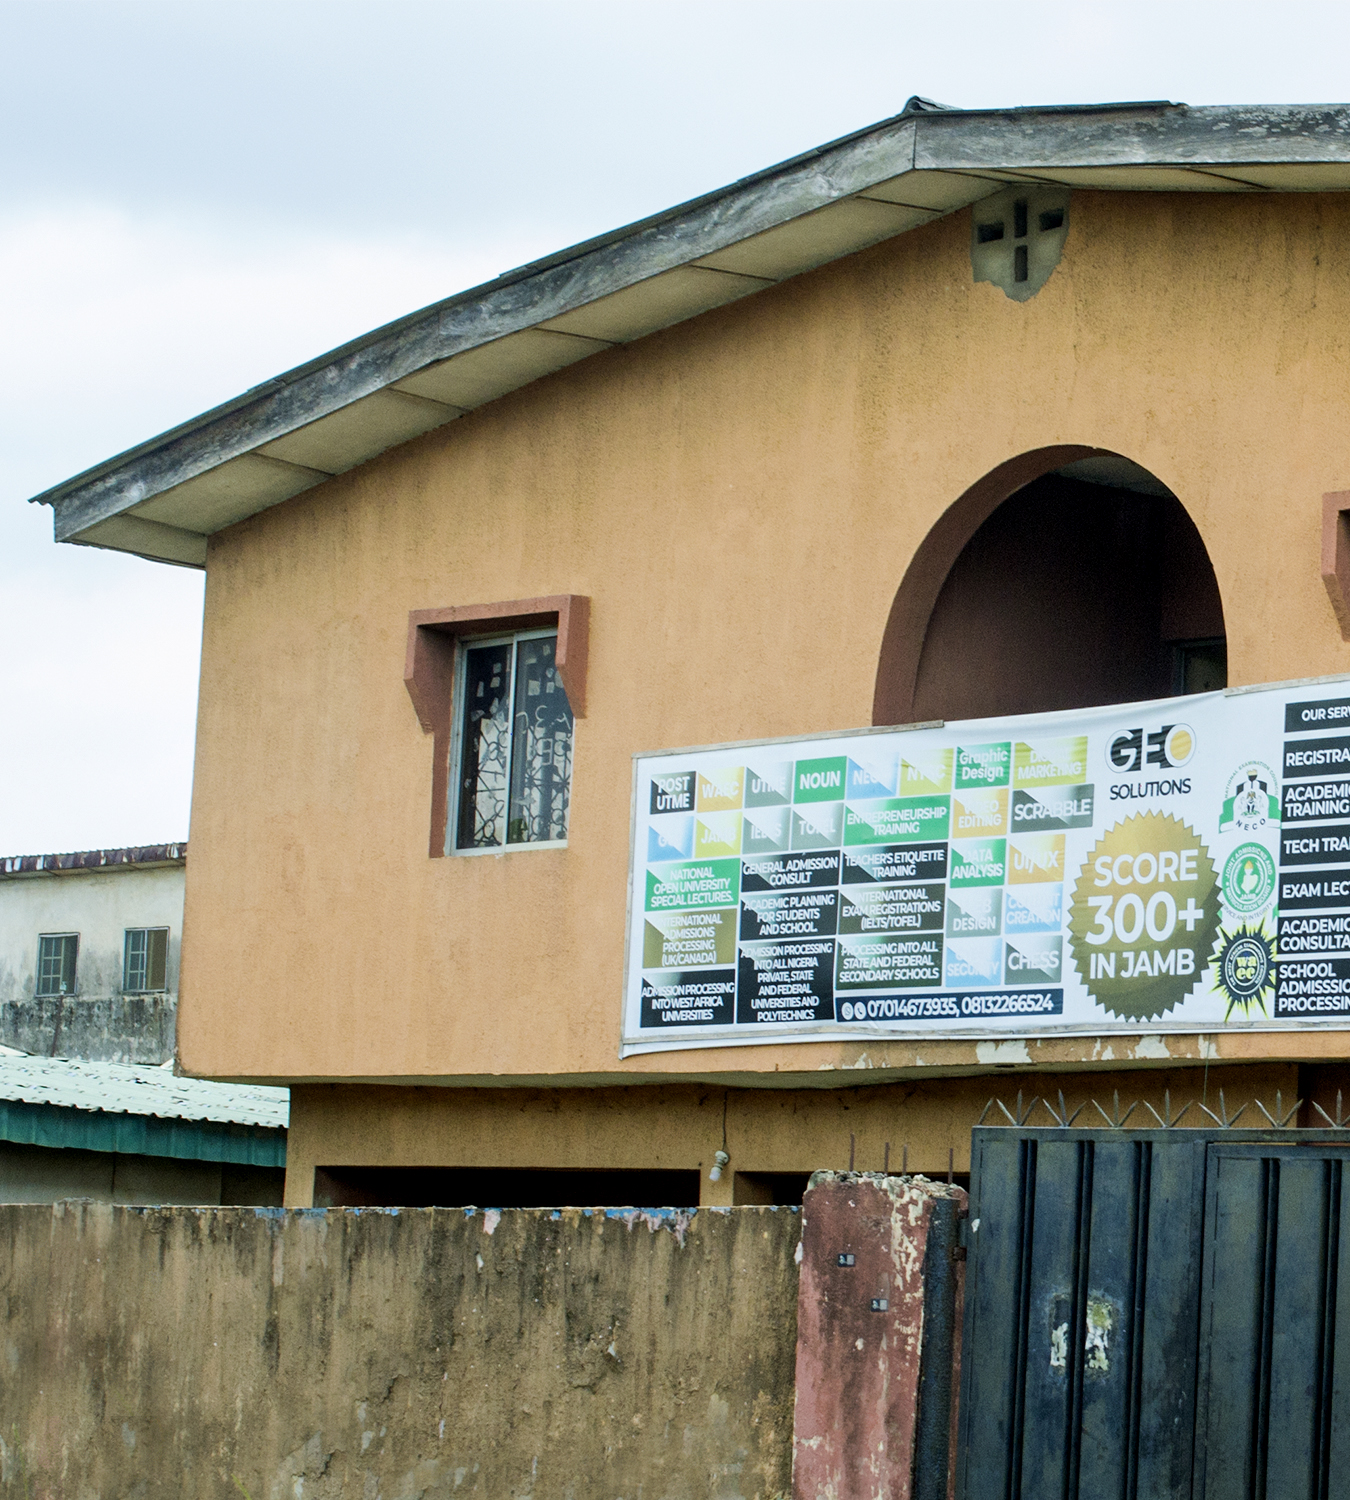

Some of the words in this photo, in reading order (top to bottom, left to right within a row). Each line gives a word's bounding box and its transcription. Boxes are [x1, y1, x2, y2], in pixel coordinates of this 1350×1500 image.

[1301, 709, 1326, 722] OUR
[1105, 722, 1197, 774] GEO
[959, 747, 1009, 768] Graphic
[962, 764, 1003, 782] Design
[1017, 761, 1082, 780] MARKETING
[657, 776, 690, 793] POST
[800, 770, 841, 790] NOUN
[1110, 778, 1191, 800] SOLUTIONS
[656, 793, 690, 811] UTME
[1014, 798, 1091, 821] SCRABBLE
[1285, 799, 1350, 817] TRAINING
[847, 806, 947, 825] ENTREPRENEURSHIP
[958, 814, 1002, 829] EDITING
[751, 823, 783, 840] IES
[872, 822, 920, 837] TRAINING
[1235, 818, 1266, 831] NECO
[1283, 838, 1319, 854] TECH
[894, 849, 945, 864] ETIQUETTE
[963, 848, 993, 864] DATA
[670, 867, 715, 880] NATIONAL
[743, 860, 785, 875] GENERAL
[785, 857, 838, 872] ADMISSION
[872, 864, 917, 878] TRAINING
[952, 863, 1004, 880] ANALYSIS
[1094, 849, 1199, 887] SCORE
[1225, 857, 1236, 878] JOINT
[653, 880, 680, 895] OPEN
[680, 878, 731, 893] UNIVERSITY
[769, 871, 812, 886] CONSULT
[651, 893, 687, 908] SPECIAL
[687, 890, 734, 905] LECTURES.
[855, 888, 928, 903] INTERNATIONAL
[1282, 883, 1321, 899] EXAM
[743, 896, 787, 911] ACADEMIC
[787, 894, 835, 909] PLANNING
[842, 904, 869, 917] EXAM
[869, 901, 941, 916] REGISTRATIONS
[661, 913, 723, 928] NTERNATIONAL
[757, 911, 776, 923] FOR
[776, 908, 820, 922] STUDENTS
[861, 914, 921, 931] (IELTS/TOFEL)
[953, 916, 996, 931] DESIGN
[1085, 890, 1204, 945] 300+
[664, 926, 716, 940] ADMISSIONS
[759, 924, 780, 936] AND
[780, 921, 818, 934] SCHOOL.
[662, 939, 715, 953] PROCESSING
[740, 945, 782, 959] ADMISSION
[782, 942, 833, 957] PROCESSING
[841, 942, 898, 956] PROCESSING
[897, 942, 919, 954] INTO
[919, 940, 938, 953] ALL
[662, 950, 717, 967] (UK/CANADA)
[754, 959, 773, 971] INTO
[773, 958, 787, 970] ALL
[787, 956, 819, 969] NIGERIA
[843, 957, 870, 969] STATE
[870, 956, 891, 968] AND
[891, 953, 934, 967] FEDERAL
[1007, 950, 1060, 971] CHESS
[1090, 952, 1116, 979] IN
[1120, 948, 1195, 978] JAMB
[757, 971, 790, 984] PRIVATE,
[790, 970, 814, 982] STATE
[839, 970, 893, 983] SECONDARY
[893, 967, 940, 981] SCHOOLS
[1279, 963, 1336, 979] SCHOOL
[641, 983, 686, 998] ADMISSION
[686, 982, 735, 996] PROCESSING
[758, 985, 777, 996] AND
[777, 983, 812, 995] FEDERAL
[652, 998, 672, 1010] INTO
[672, 997, 695, 1009] WEST
[694, 995, 724, 1008] AFRICA
[751, 997, 801, 1009] UNIVERSITIES
[801, 996, 819, 1007] AND
[867, 999, 960, 1018] 07014673935,
[962, 994, 1054, 1014] 08132266524
[662, 1009, 714, 1022] UNIVERSITIES
[757, 1009, 815, 1022] POLYTECHNICS
